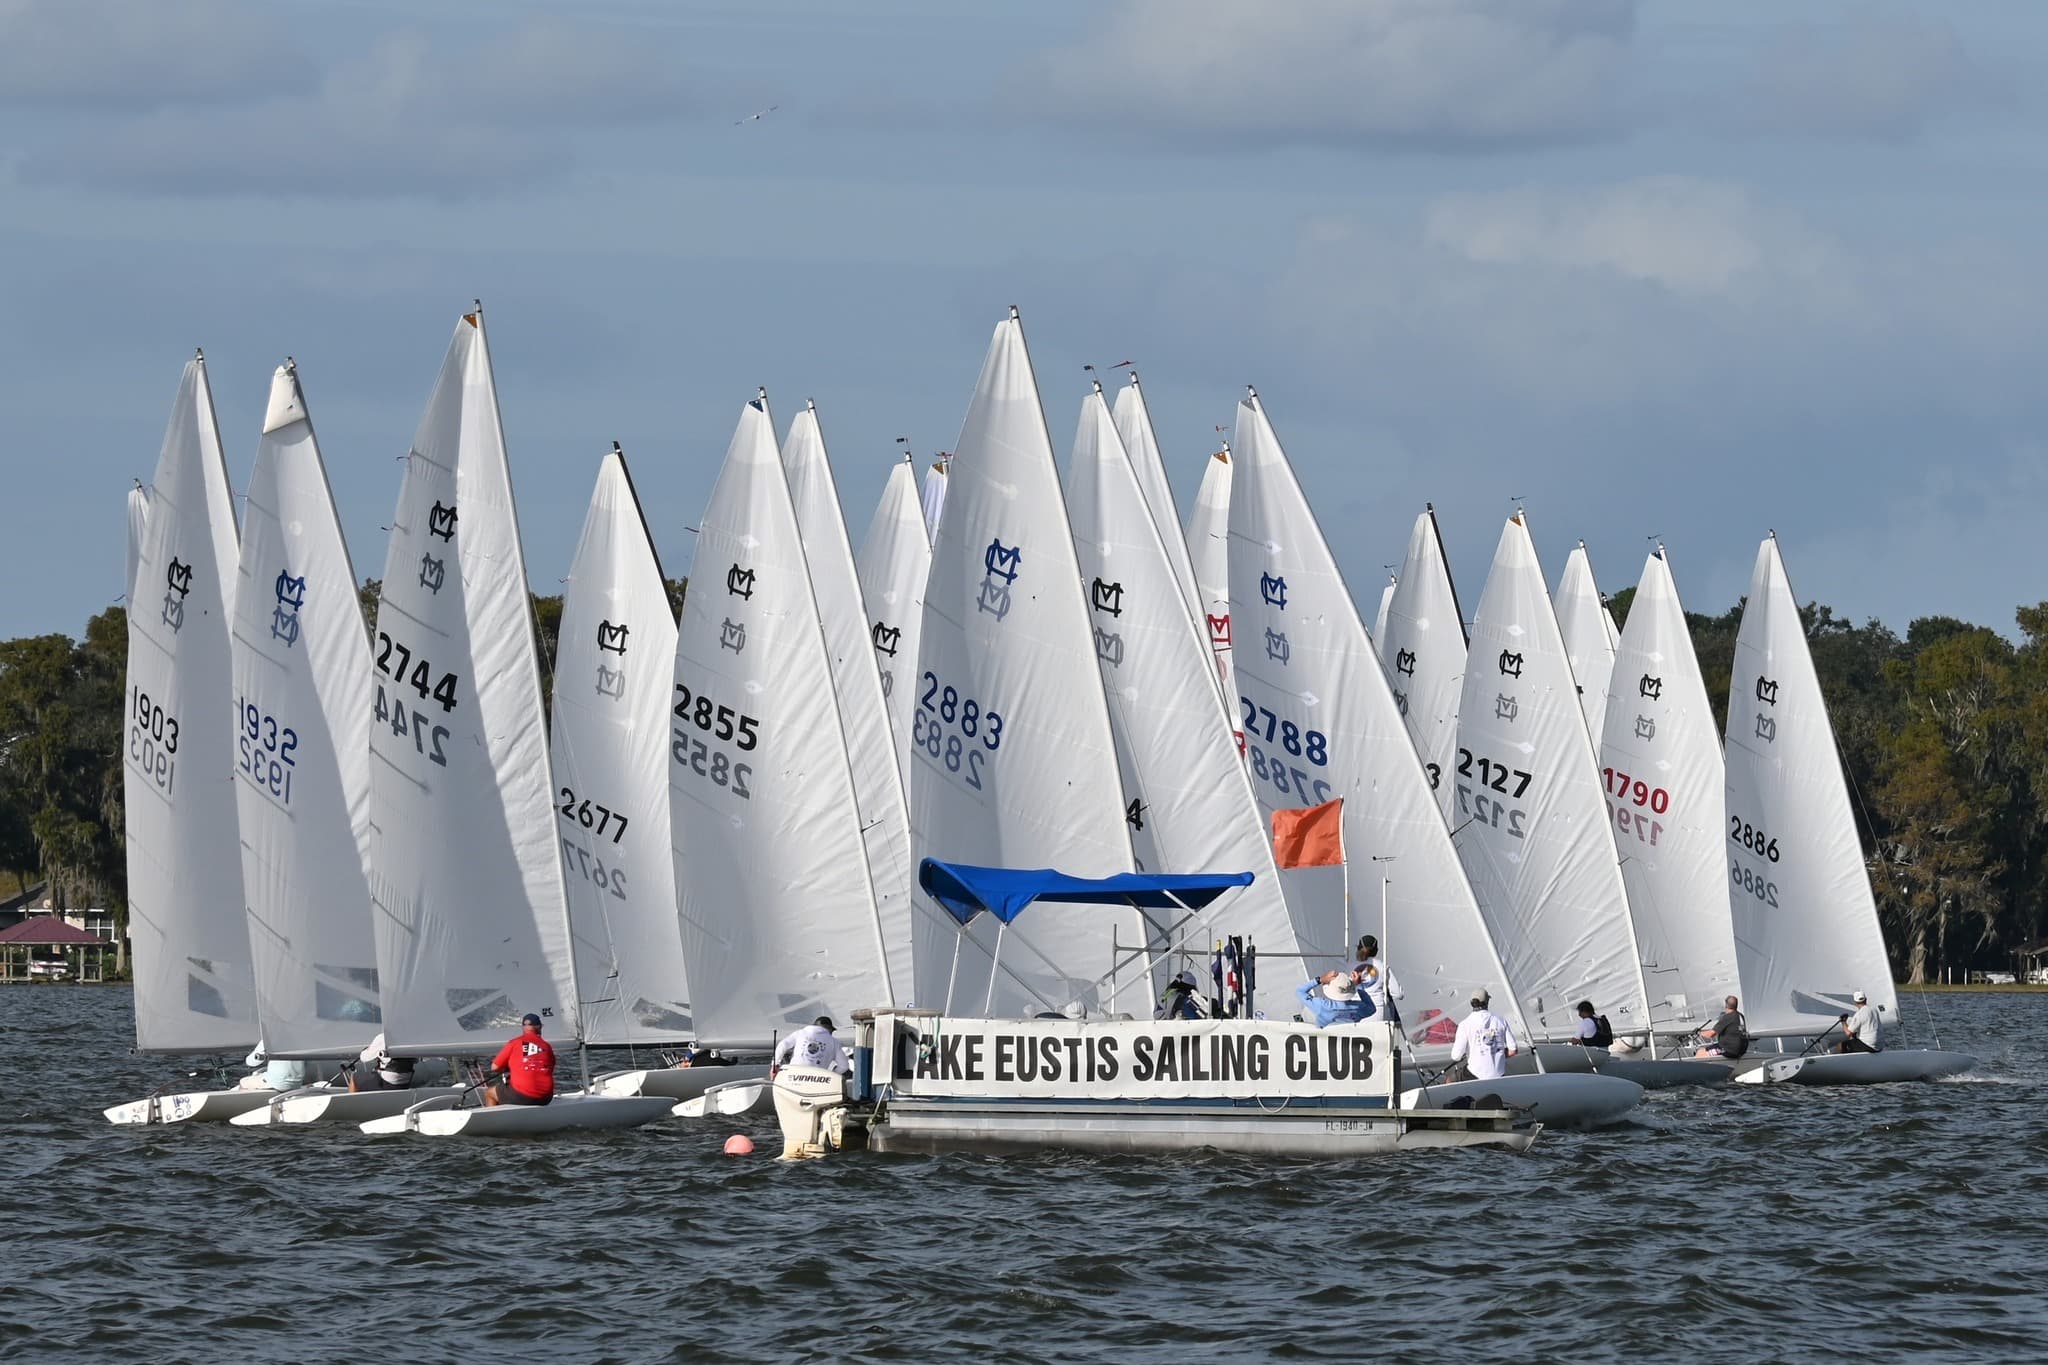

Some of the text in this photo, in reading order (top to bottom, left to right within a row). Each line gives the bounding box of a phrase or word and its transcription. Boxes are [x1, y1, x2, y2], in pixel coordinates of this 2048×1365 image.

[377, 632, 458, 712] 2744
[133, 685, 179, 754] 1903
[240, 696, 298, 767] 1932
[674, 683, 759, 751] 2855
[921, 671, 1003, 750] 2883
[1240, 696, 1328, 766] 2788
[1457, 748, 1532, 798] 2127
[1603, 767, 1669, 814] 1790
[561, 787, 628, 844] 2677
[1730, 815, 1780, 863] 2886
[788, 1074, 831, 1084] EVINRUDE
[896, 1033, 1374, 1083] LAKE EUSTIS SAILING CLUB
